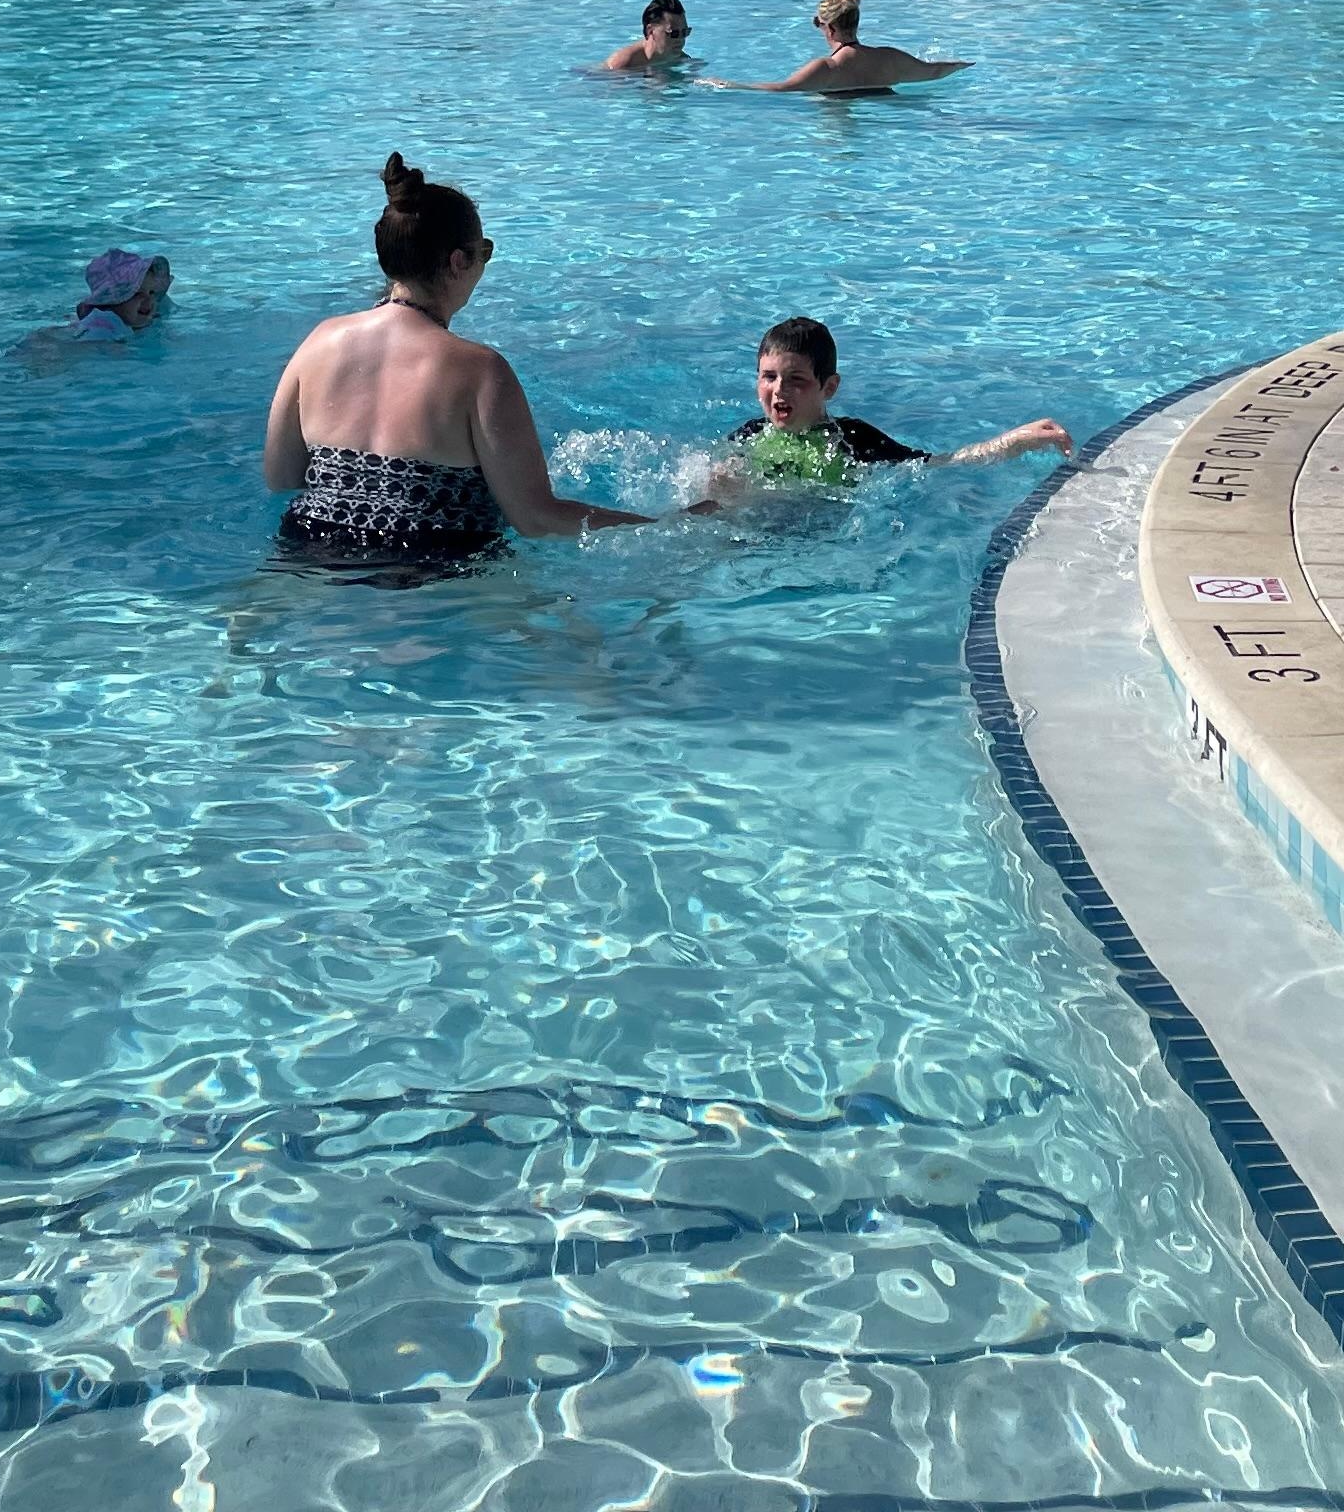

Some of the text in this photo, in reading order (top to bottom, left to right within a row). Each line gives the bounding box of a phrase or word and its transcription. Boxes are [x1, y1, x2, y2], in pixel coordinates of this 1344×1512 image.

[1258, 360, 1343, 399] DEEP
[1233, 403, 1295, 426] AT
[1213, 426, 1275, 445] IN
[1205, 447, 1261, 459] 6
[1192, 461, 1254, 488] FT
[1189, 491, 1247, 502] 4
[1213, 625, 1321, 683] 3 FT
